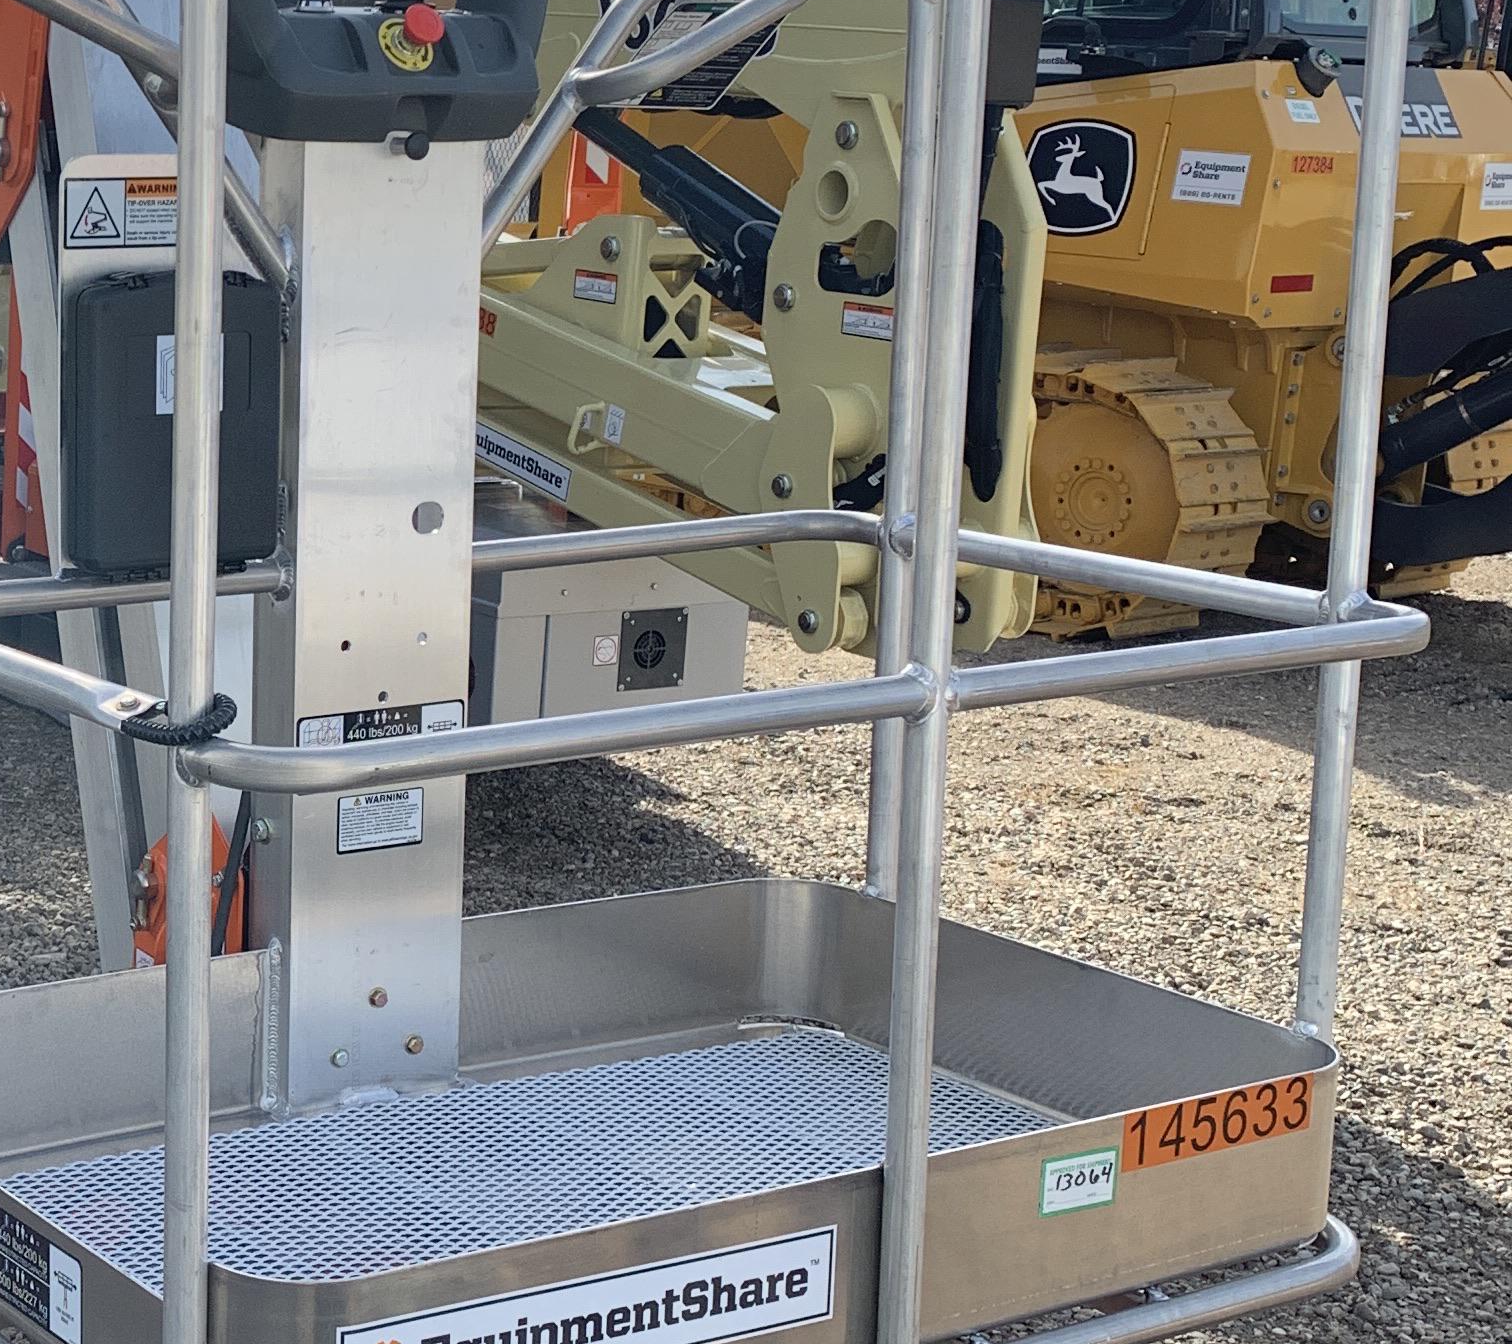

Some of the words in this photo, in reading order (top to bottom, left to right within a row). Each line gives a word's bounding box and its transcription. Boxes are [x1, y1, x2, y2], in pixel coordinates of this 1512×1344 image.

[1345, 96, 1460, 135] DERE
[1194, 160, 1245, 173] Equipment
[1292, 156, 1334, 174] 127384
[1192, 170, 1220, 181] Share
[137, 184, 178, 194] WARNIN
[476, 434, 564, 488] uipmentShare
[347, 728, 366, 740] 440
[368, 724, 404, 738] lbs/200
[406, 723, 419, 734] kg
[364, 791, 409, 805] WARNING
[1130, 1076, 1308, 1165] 145633
[1055, 1162, 1113, 1191] 13064
